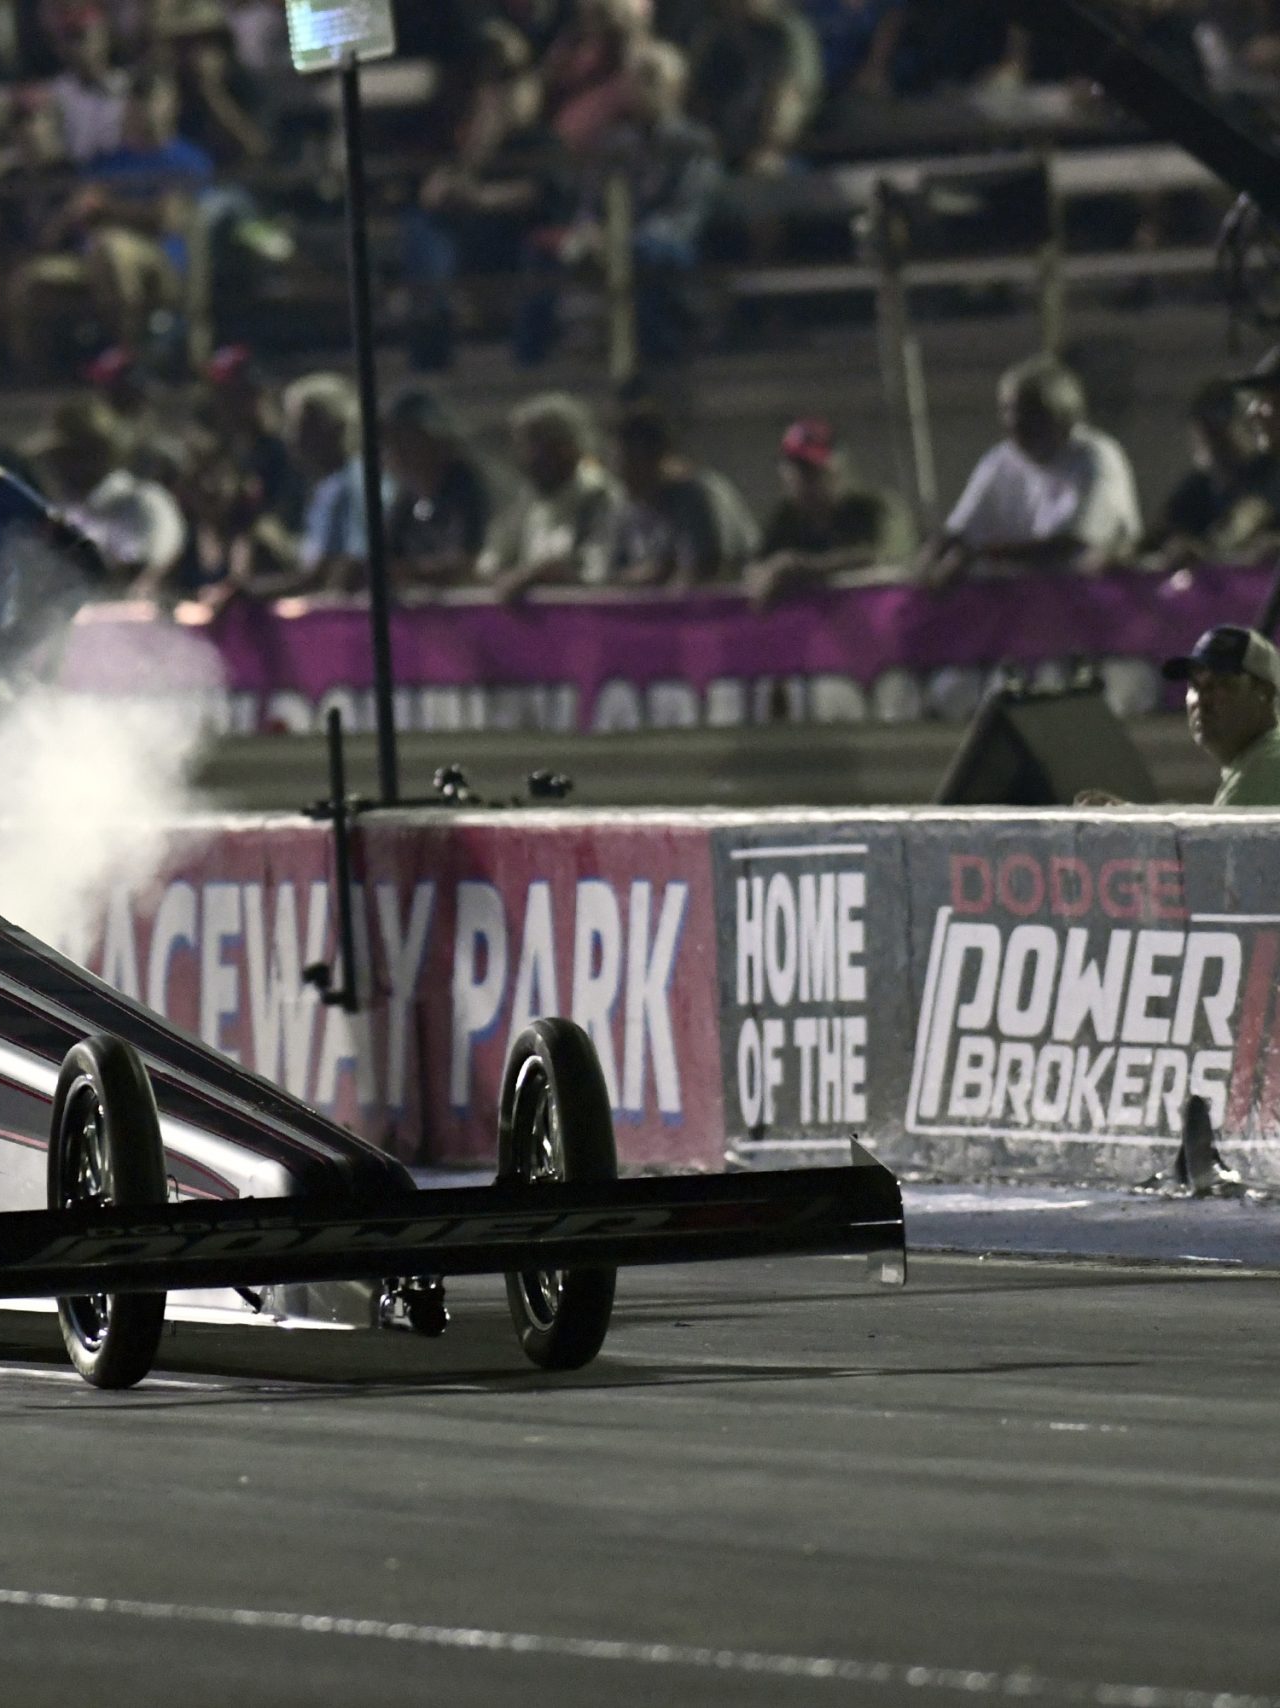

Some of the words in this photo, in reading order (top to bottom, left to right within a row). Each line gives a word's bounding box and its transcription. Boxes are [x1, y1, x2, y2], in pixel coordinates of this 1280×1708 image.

[949, 854, 1192, 920] DODGE
[737, 873, 867, 1006] HOME
[100, 879, 436, 1120] ACEWAY
[450, 878, 689, 1126] PARK
[916, 922, 1242, 1118] POWER
[737, 1018, 785, 1128] OF
[793, 1016, 867, 1125] THE
[948, 1034, 1233, 1131] BROKERS
[28, 1208, 673, 1266] POWER
[86, 1216, 303, 1238] DODGE
